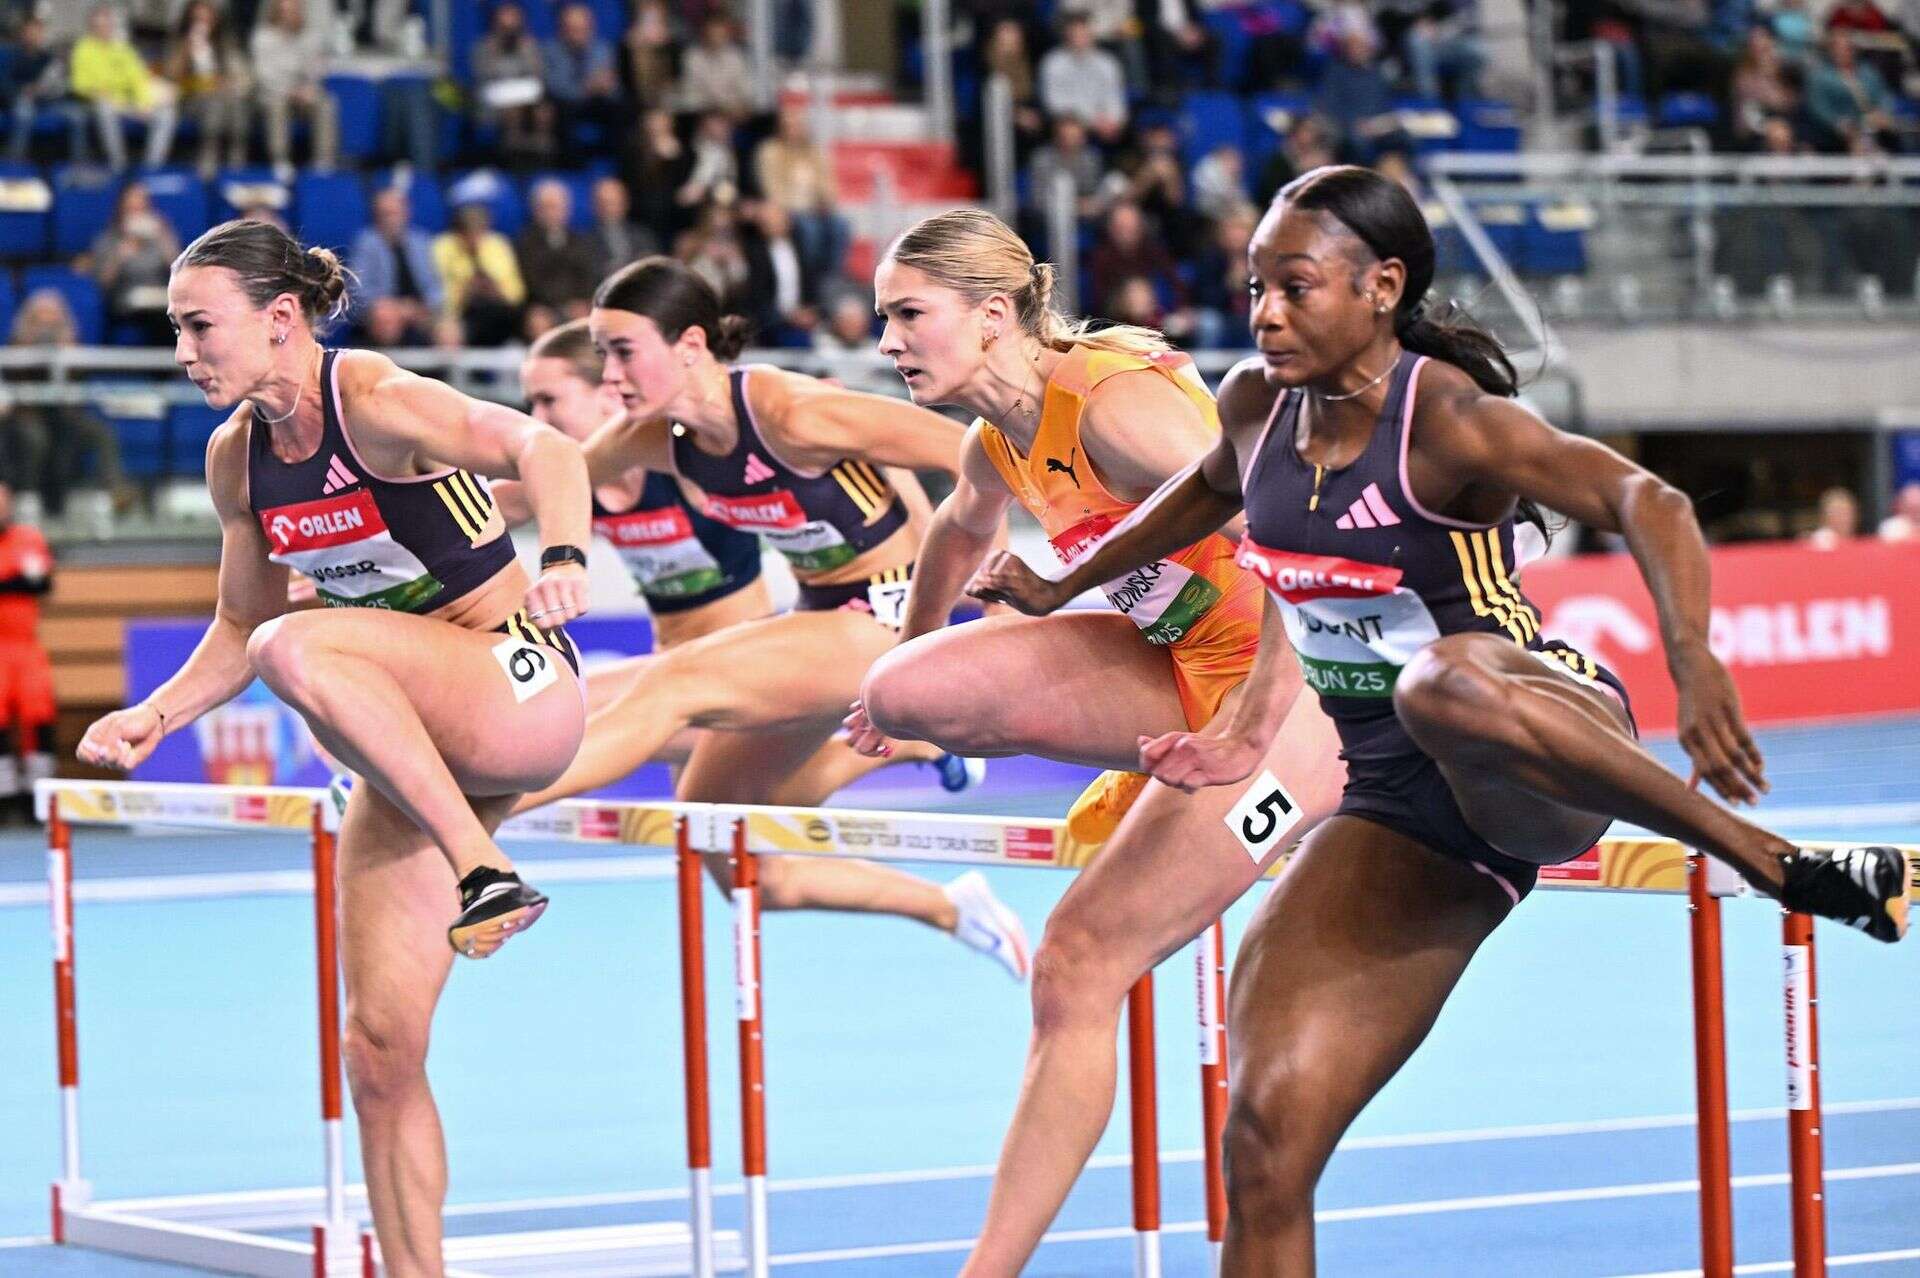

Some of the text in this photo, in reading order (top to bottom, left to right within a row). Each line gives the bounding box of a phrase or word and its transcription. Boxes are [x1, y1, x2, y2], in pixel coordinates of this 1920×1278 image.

[299, 507, 364, 538] ORLEN
[882, 588, 906, 619] 7
[1708, 596, 1891, 667] ORLEN
[509, 647, 546, 683] 6
[1350, 671, 1387, 692] 25
[1242, 789, 1293, 844] 5
